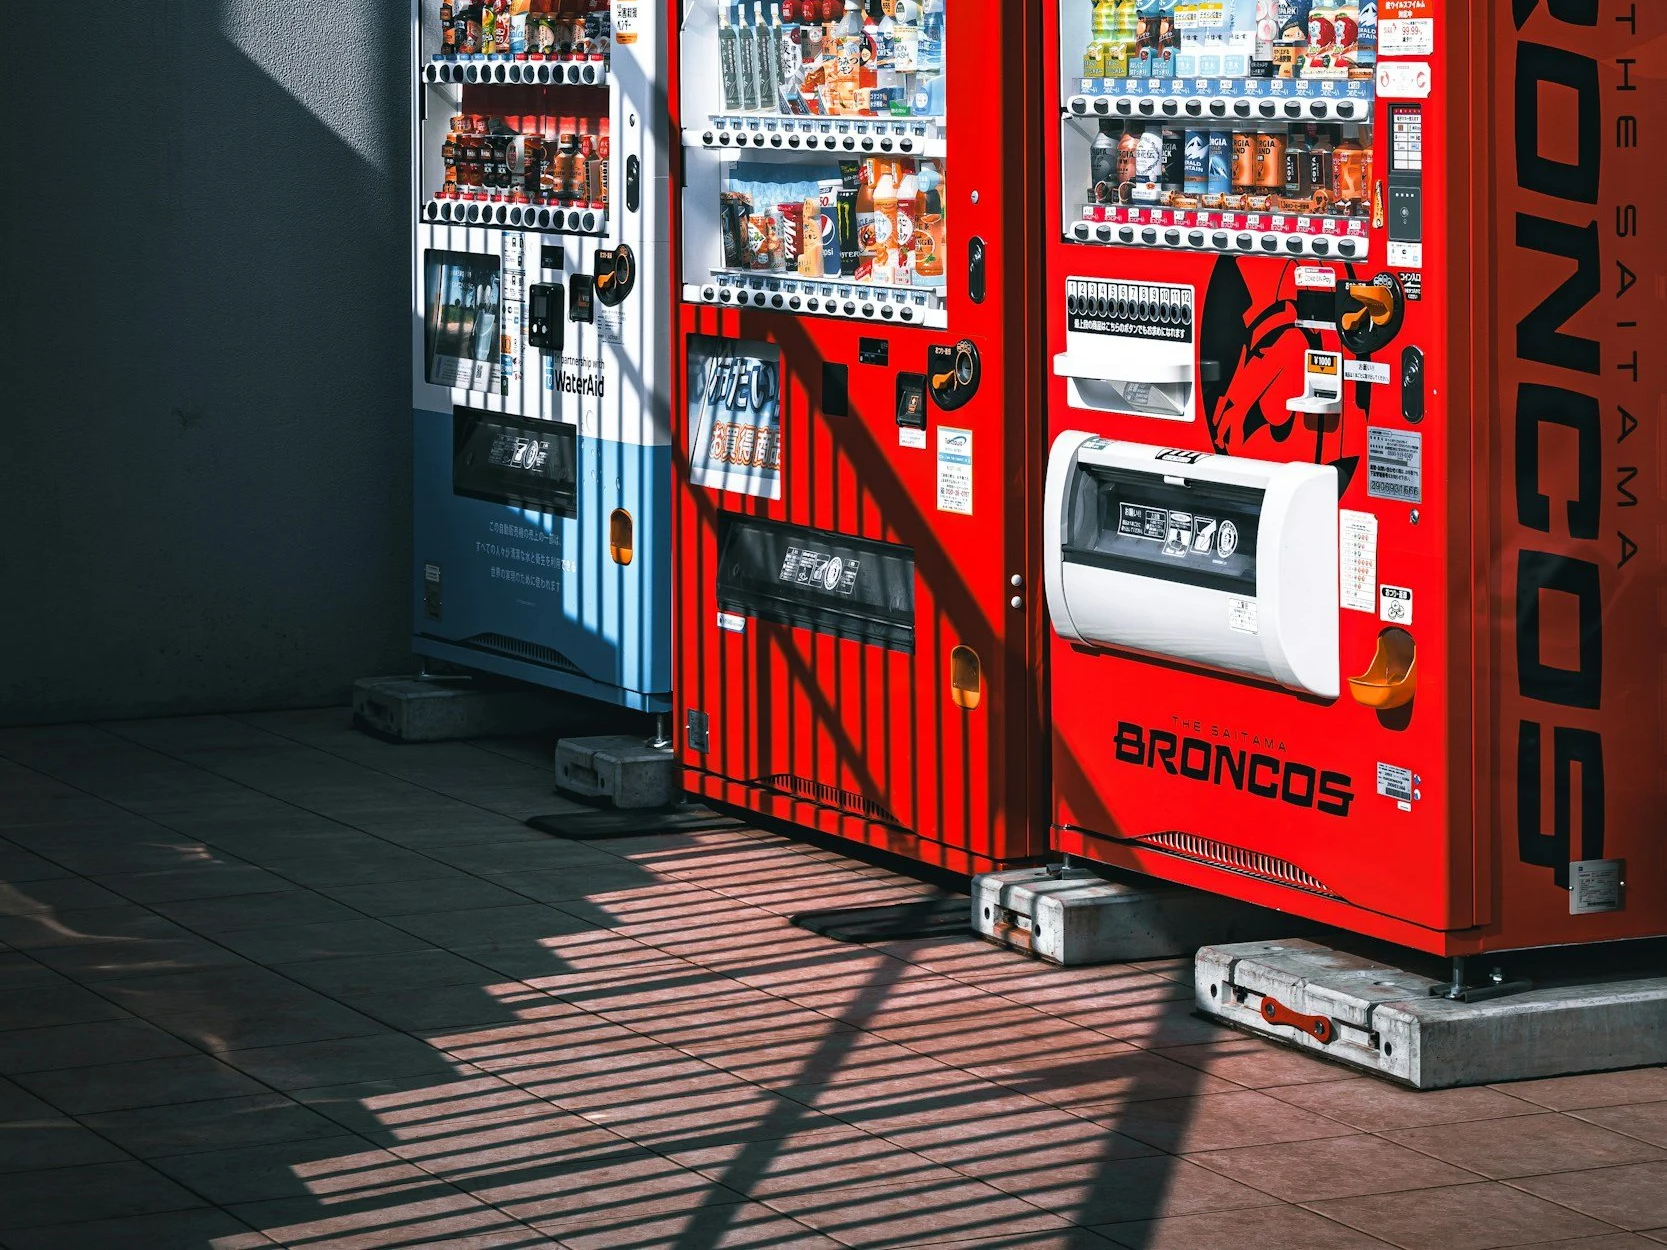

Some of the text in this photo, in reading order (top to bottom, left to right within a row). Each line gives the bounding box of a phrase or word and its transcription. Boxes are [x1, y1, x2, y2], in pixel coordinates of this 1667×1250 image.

[1070, 283, 1074, 291] 1
[1121, 286, 1126, 294] 6
[1131, 287, 1136, 295] 7
[1142, 288, 1146, 296] 8
[1152, 289, 1157, 297] 9
[1162, 290, 1169, 299] 10
[1172, 291, 1179, 300] 11
[1183, 292, 1190, 301] 12
[1614, 3, 1638, 570] THE SAITAMA
[560, 356, 591, 370] partnership
[593, 358, 605, 370] with
[1313, 356, 1331, 366] ¥1000
[555, 369, 605, 398] WaterAid
[1172, 715, 1288, 752] THE SAITAMA
[1113, 721, 1354, 818] BRONCOS
